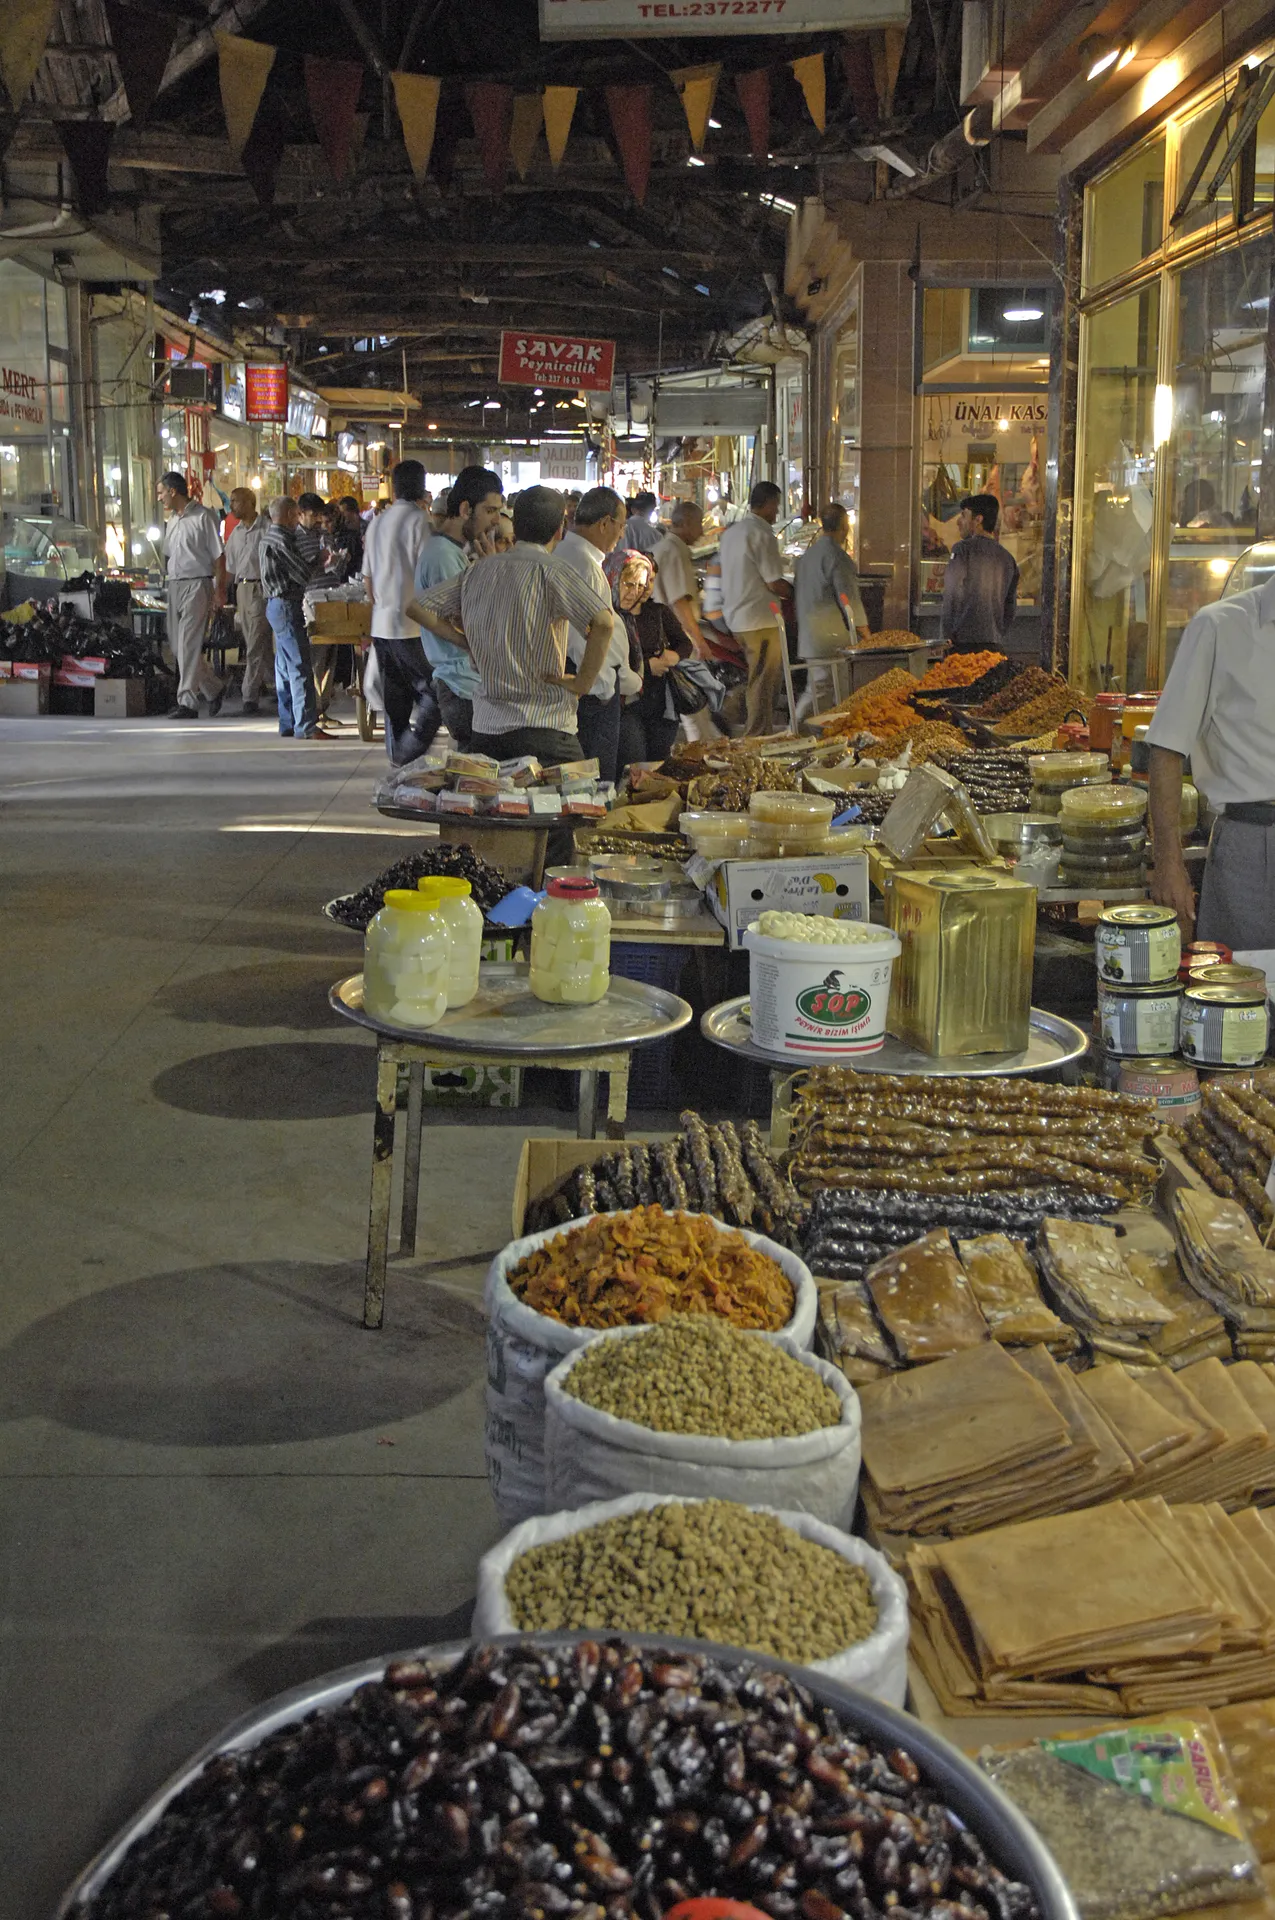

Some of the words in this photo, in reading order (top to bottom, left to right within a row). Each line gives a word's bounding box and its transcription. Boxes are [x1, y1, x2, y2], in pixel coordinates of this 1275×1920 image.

[638, 1, 786, 18] TEL:2372277
[515, 340, 602, 361] SAVAK
[520, 357, 596, 374] Peynircilik
[2, 366, 36, 400] MERT
[955, 401, 1001, 420] ÜNAL
[1010, 405, 1048, 420] KAS
[811, 993, 860, 1014] ŞOP
[1125, 1083, 1173, 1096] MESUT
